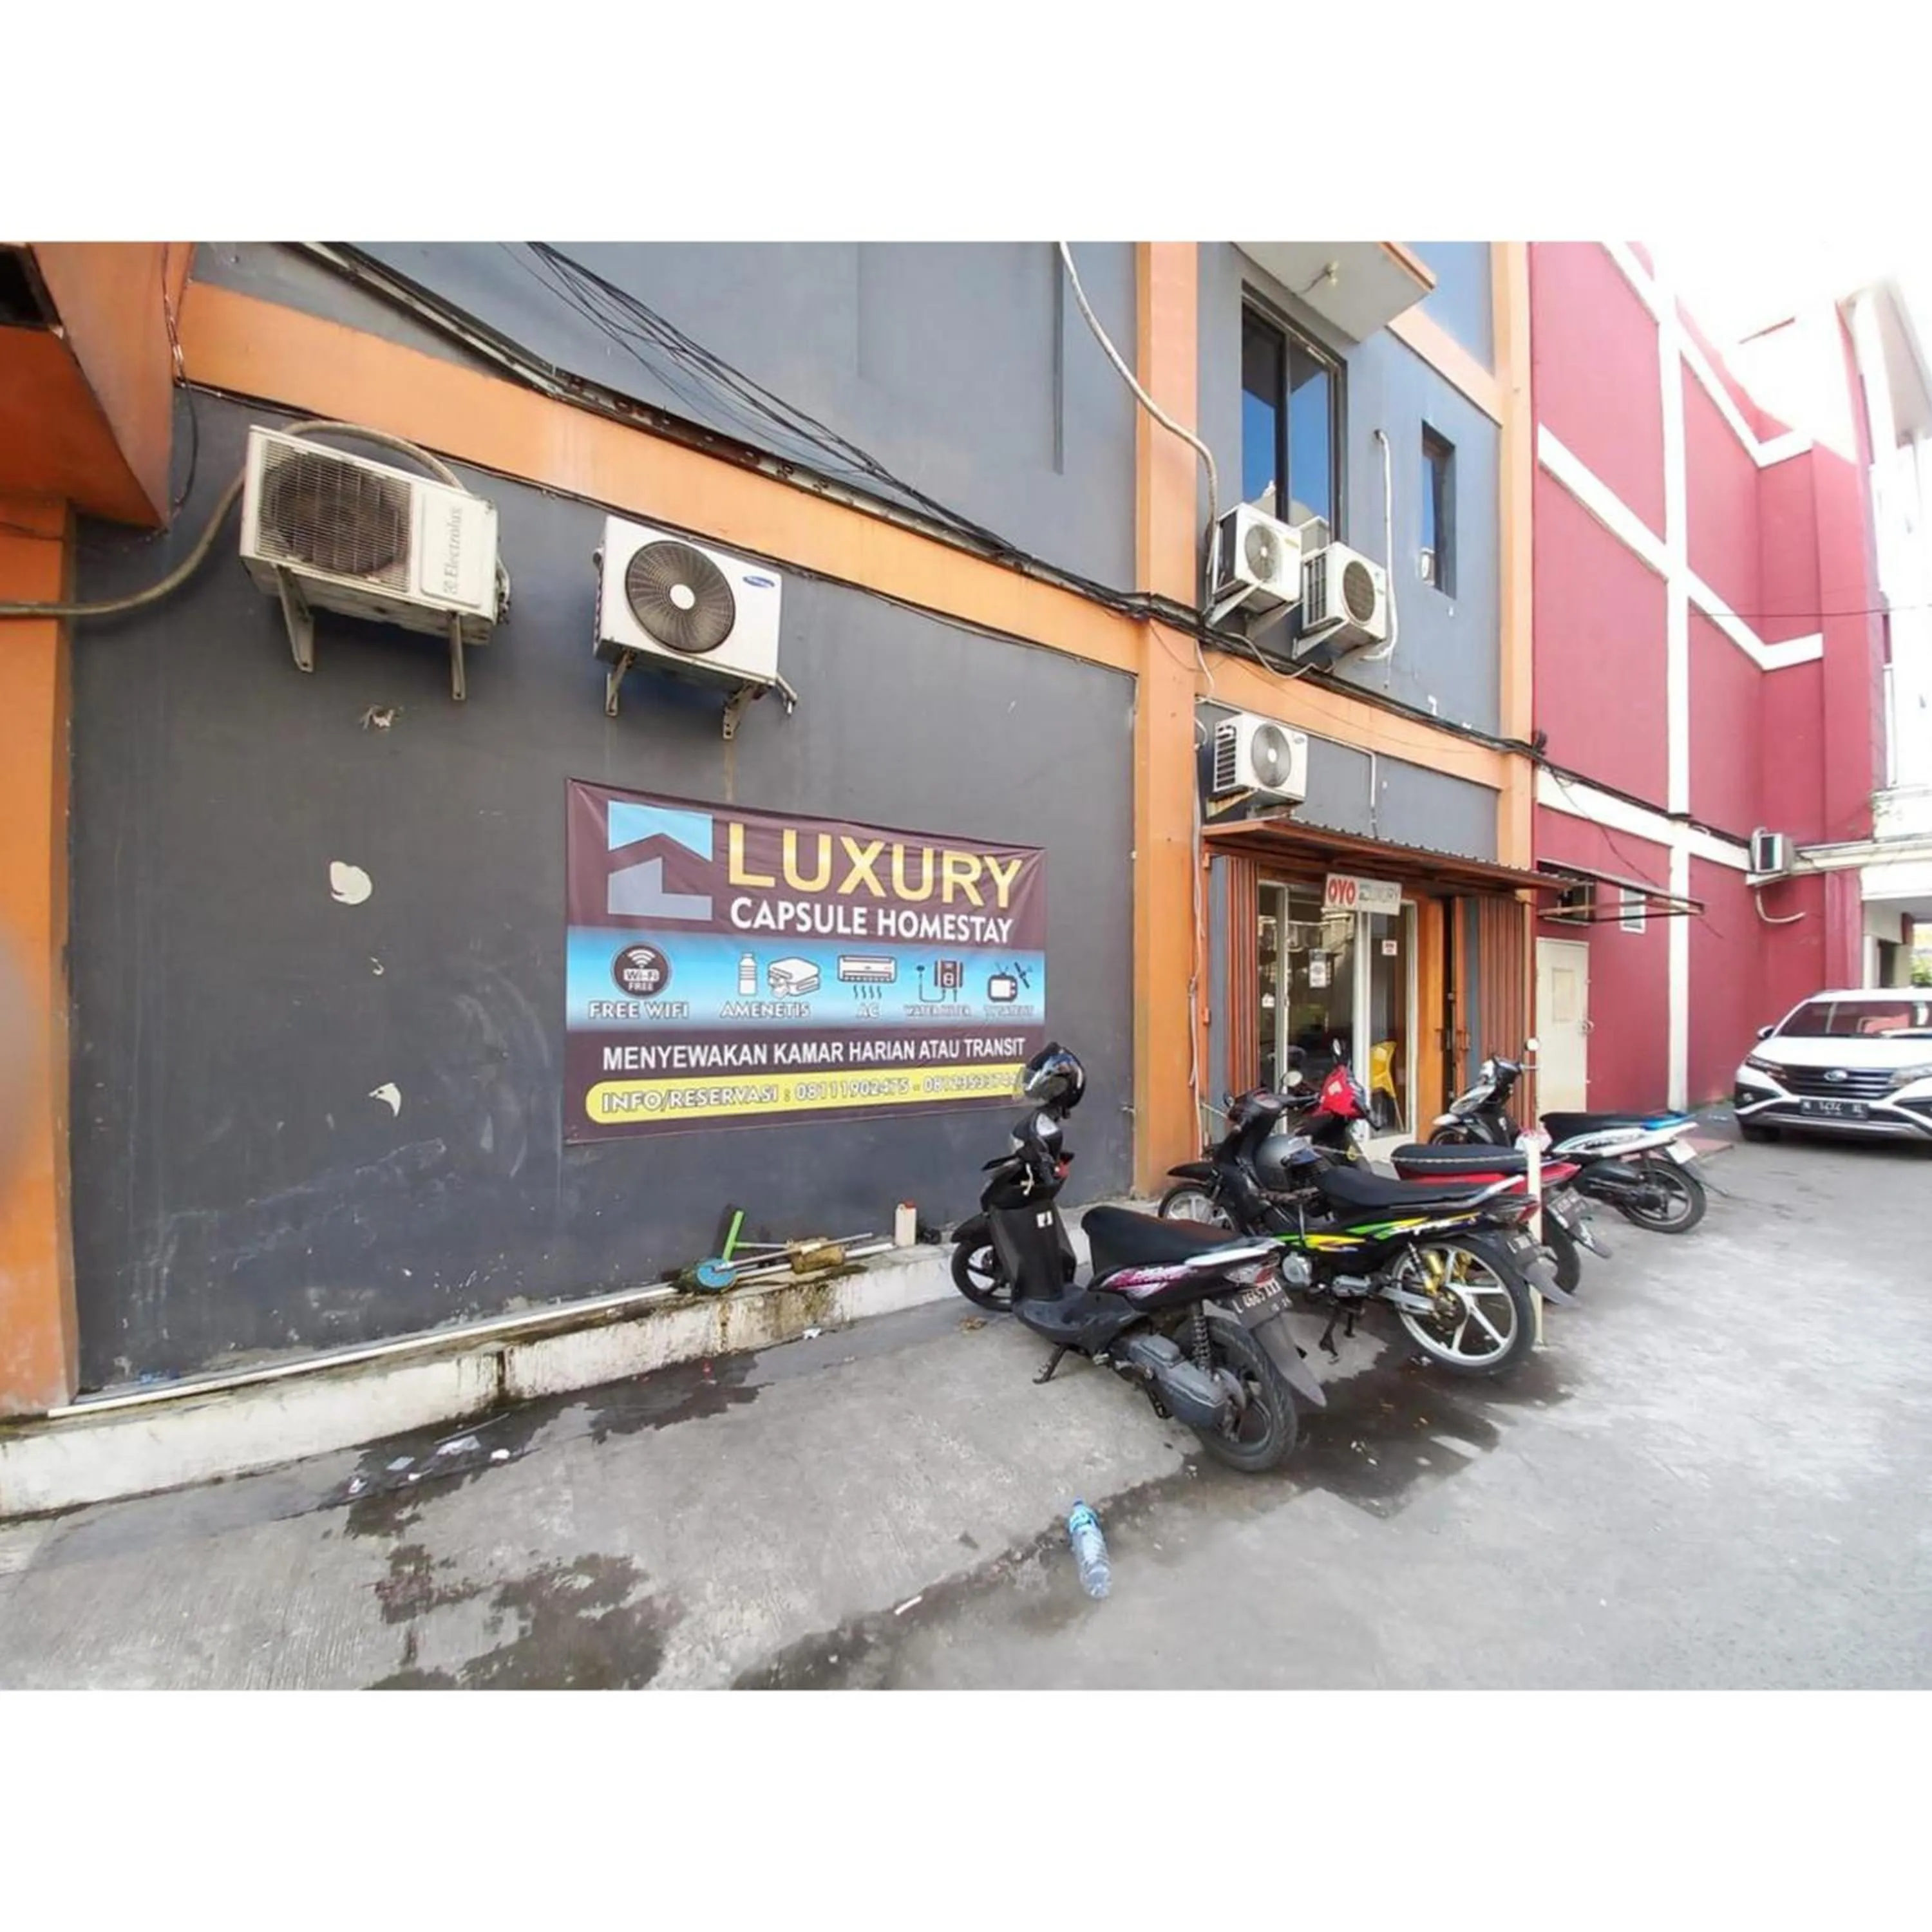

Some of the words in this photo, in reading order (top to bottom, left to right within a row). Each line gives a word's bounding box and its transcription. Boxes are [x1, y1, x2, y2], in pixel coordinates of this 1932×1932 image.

[444, 506, 462, 578] Electrolux
[728, 822, 1023, 909] LUXURY
[1328, 878, 1356, 905] OYO
[730, 896, 868, 936] CAPSULE
[877, 908, 1014, 944] HOMESTAY
[628, 982, 654, 992] FREE
[589, 1001, 640, 1019] FREE
[645, 1001, 690, 1019] WIFI
[720, 1001, 811, 1019] AMENETIS
[857, 1003, 880, 1019] AC
[603, 1043, 767, 1070] MENYEWAKAN
[773, 1041, 843, 1065] KAMAR
[848, 1040, 915, 1062] HARIAN
[918, 1039, 960, 1059] ATAU
[963, 1037, 1026, 1057] TRANSIT
[601, 1084, 779, 1114] INFO/RESERVASI
